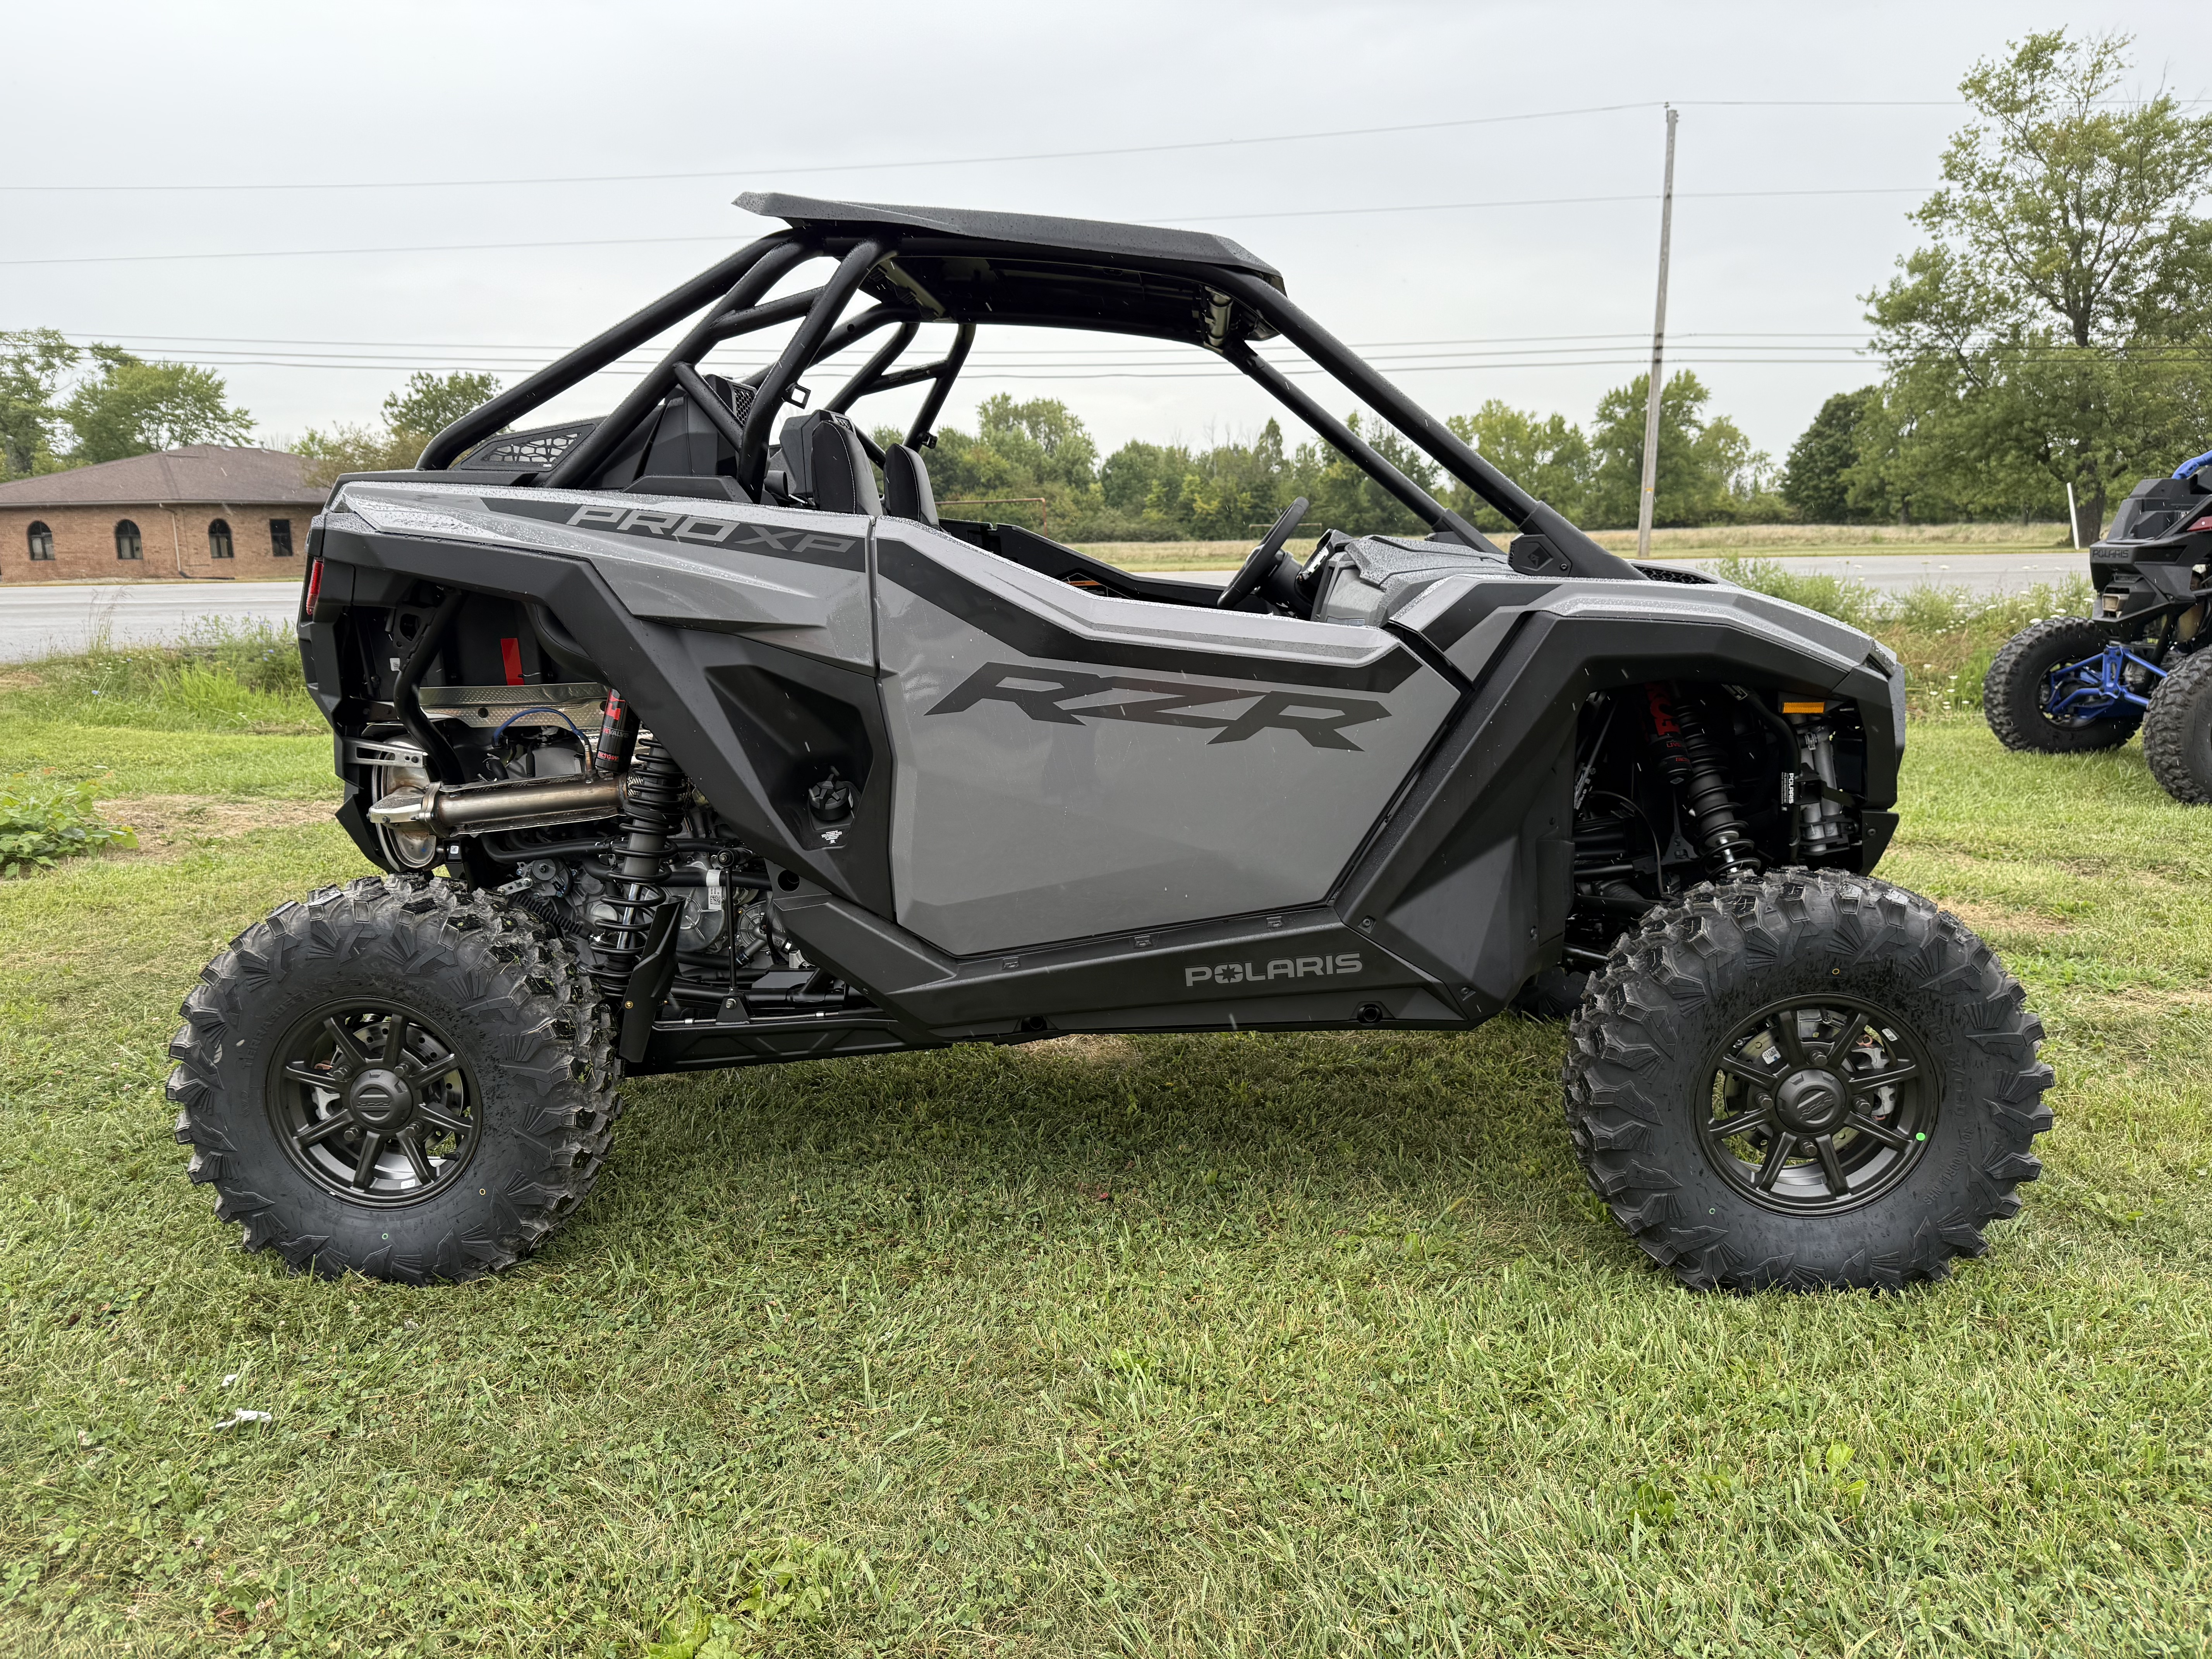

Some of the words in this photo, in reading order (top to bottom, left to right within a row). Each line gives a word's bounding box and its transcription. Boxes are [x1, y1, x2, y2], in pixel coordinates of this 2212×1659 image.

[2092, 549, 2129, 558] POLARIS
[924, 662, 1393, 751] RZR
[1185, 953, 1362, 987] POLARIS
